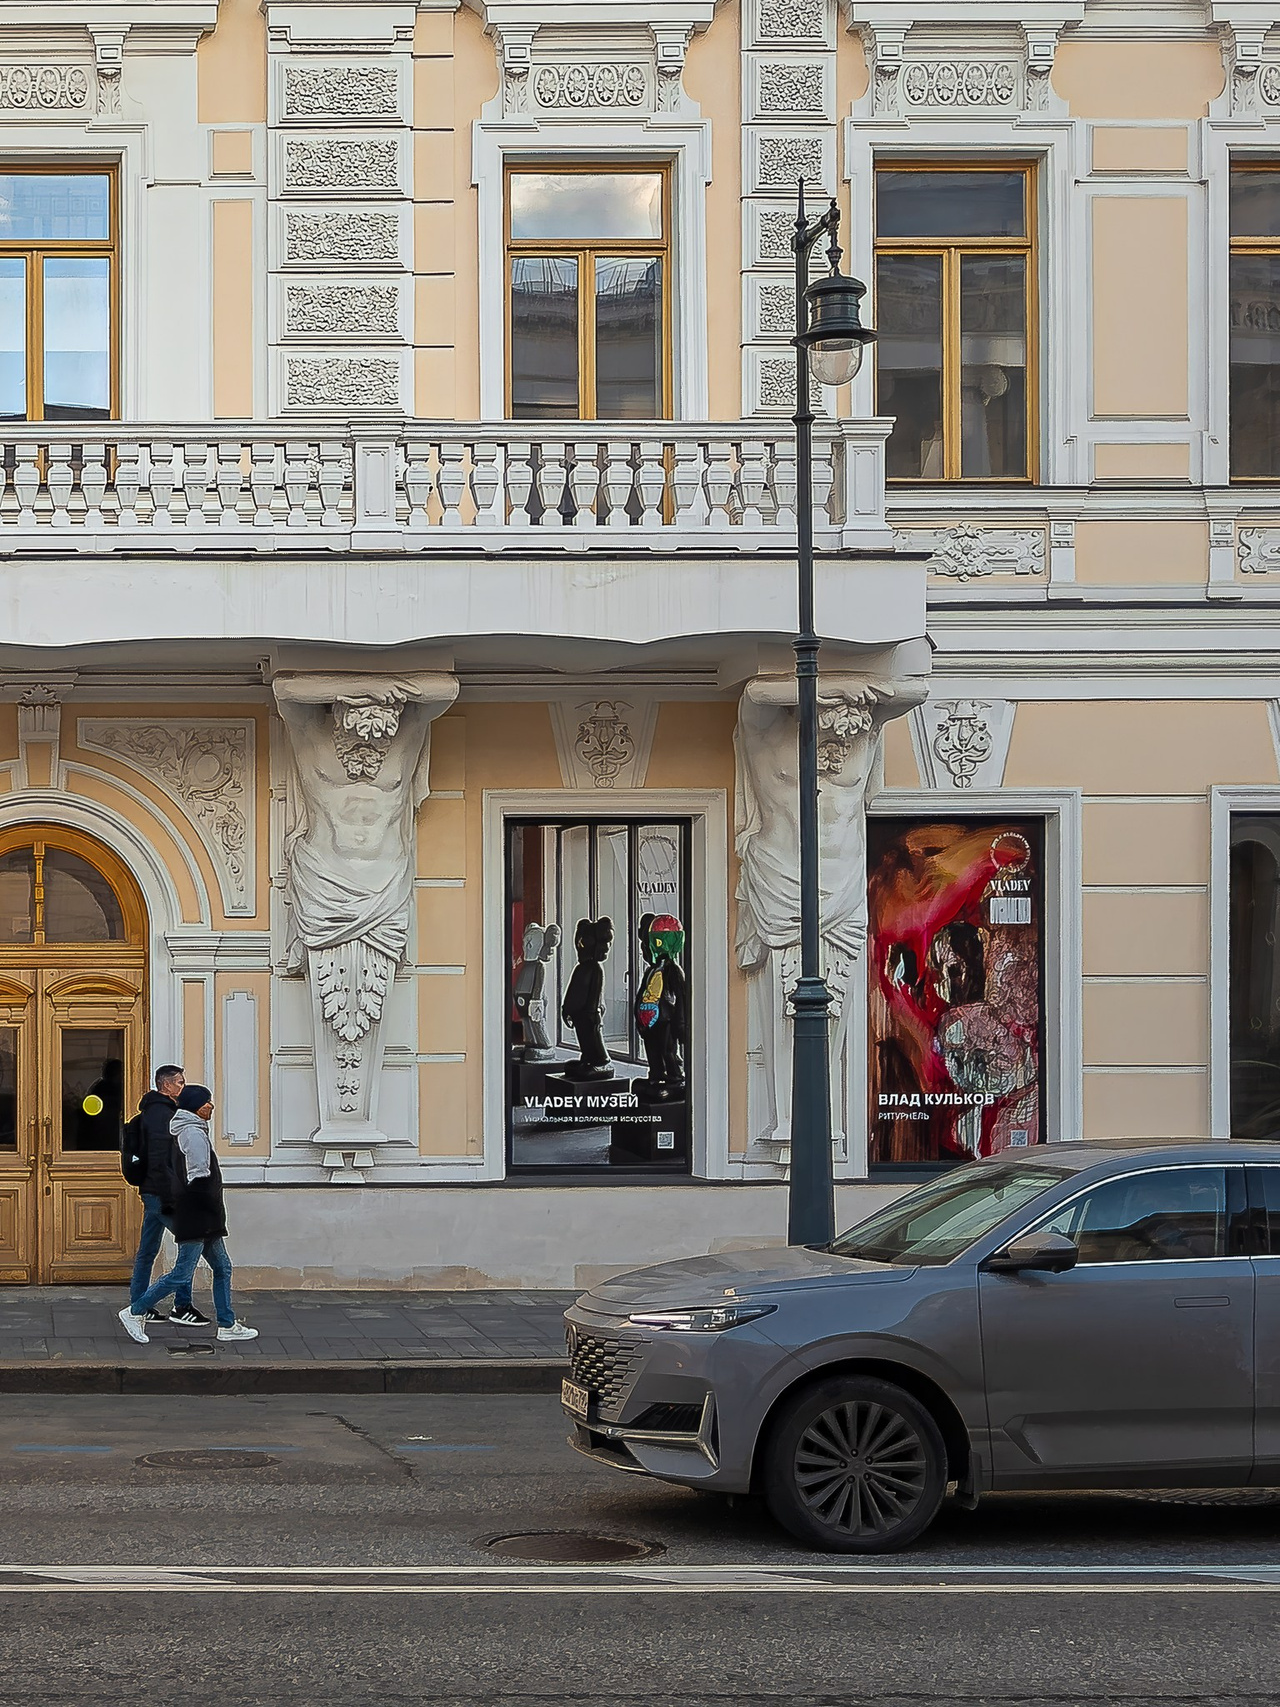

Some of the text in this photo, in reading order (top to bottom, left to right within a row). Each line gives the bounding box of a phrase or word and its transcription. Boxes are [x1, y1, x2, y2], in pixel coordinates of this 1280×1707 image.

[637, 882, 677, 894] VLADEY
[990, 879, 1031, 892] VLADEY
[524, 1094, 639, 1108] VLADEY МУЗЕЙ
[878, 1093, 995, 1107] ВЛАД КУЛЬКОВ
[878, 1112, 930, 1121] РИТУРНЕЛЬ
